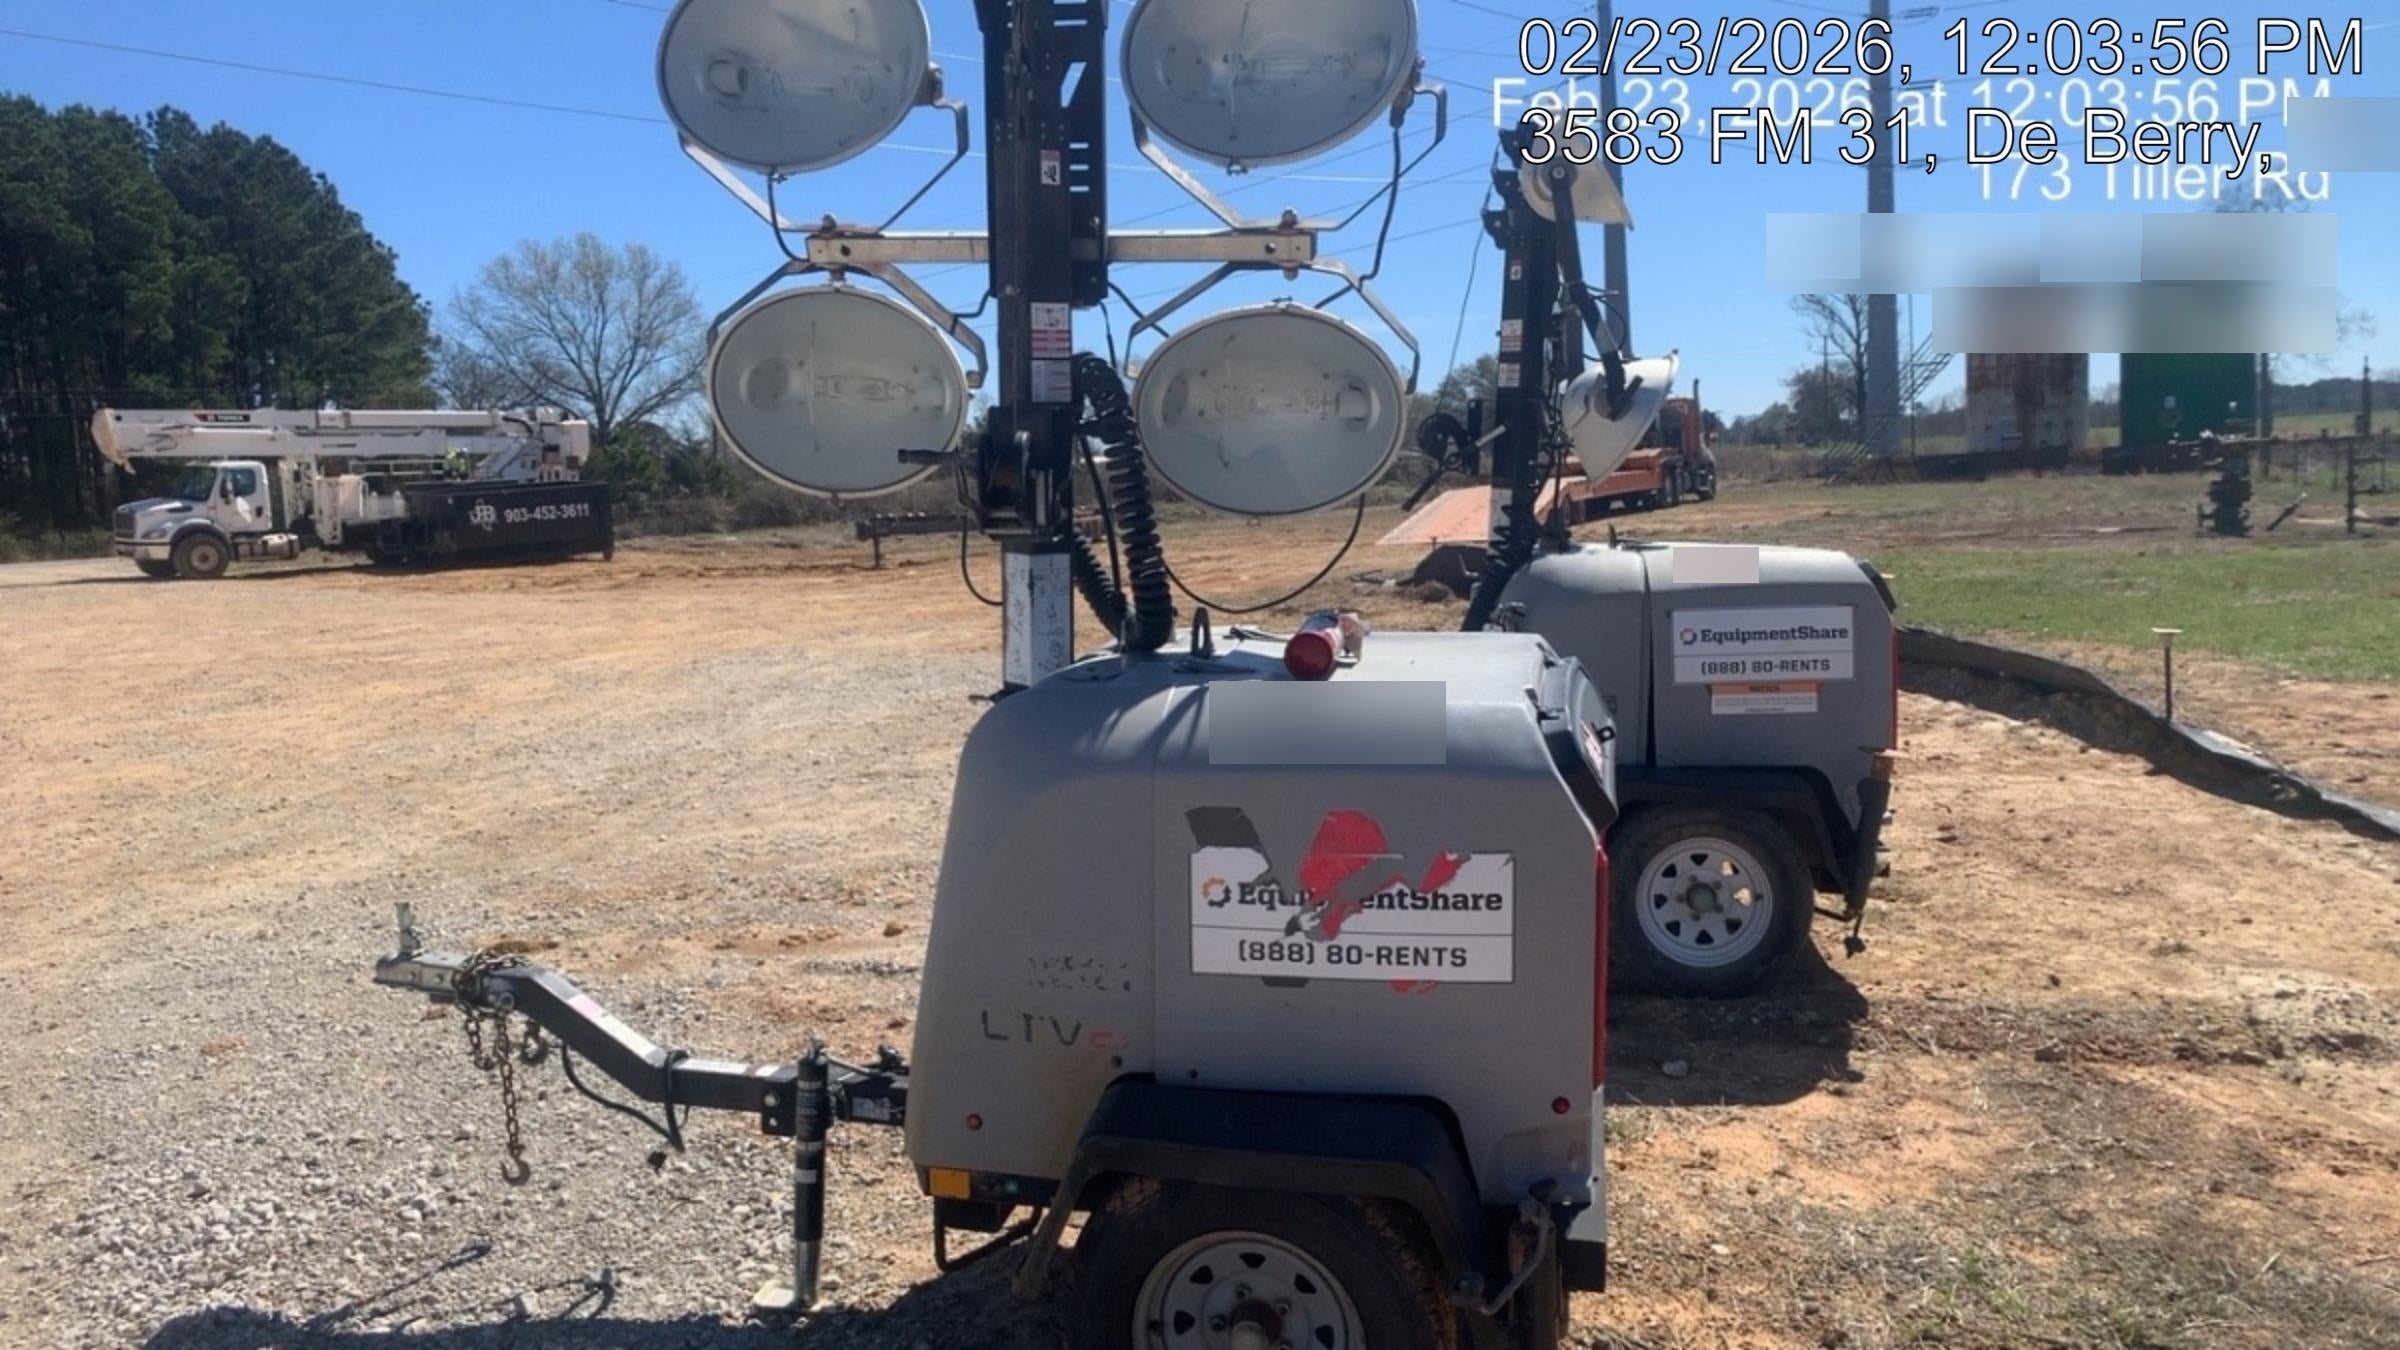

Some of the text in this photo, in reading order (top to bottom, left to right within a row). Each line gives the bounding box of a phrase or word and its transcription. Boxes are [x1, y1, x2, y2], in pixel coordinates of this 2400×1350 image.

[504, 503, 590, 523] 903-452-3611
[1701, 625, 1848, 645] EquipmentShare
[1701, 659, 1831, 676] (888) 80-RENTS
[1238, 938, 1468, 968] (888) 80-RENTS
